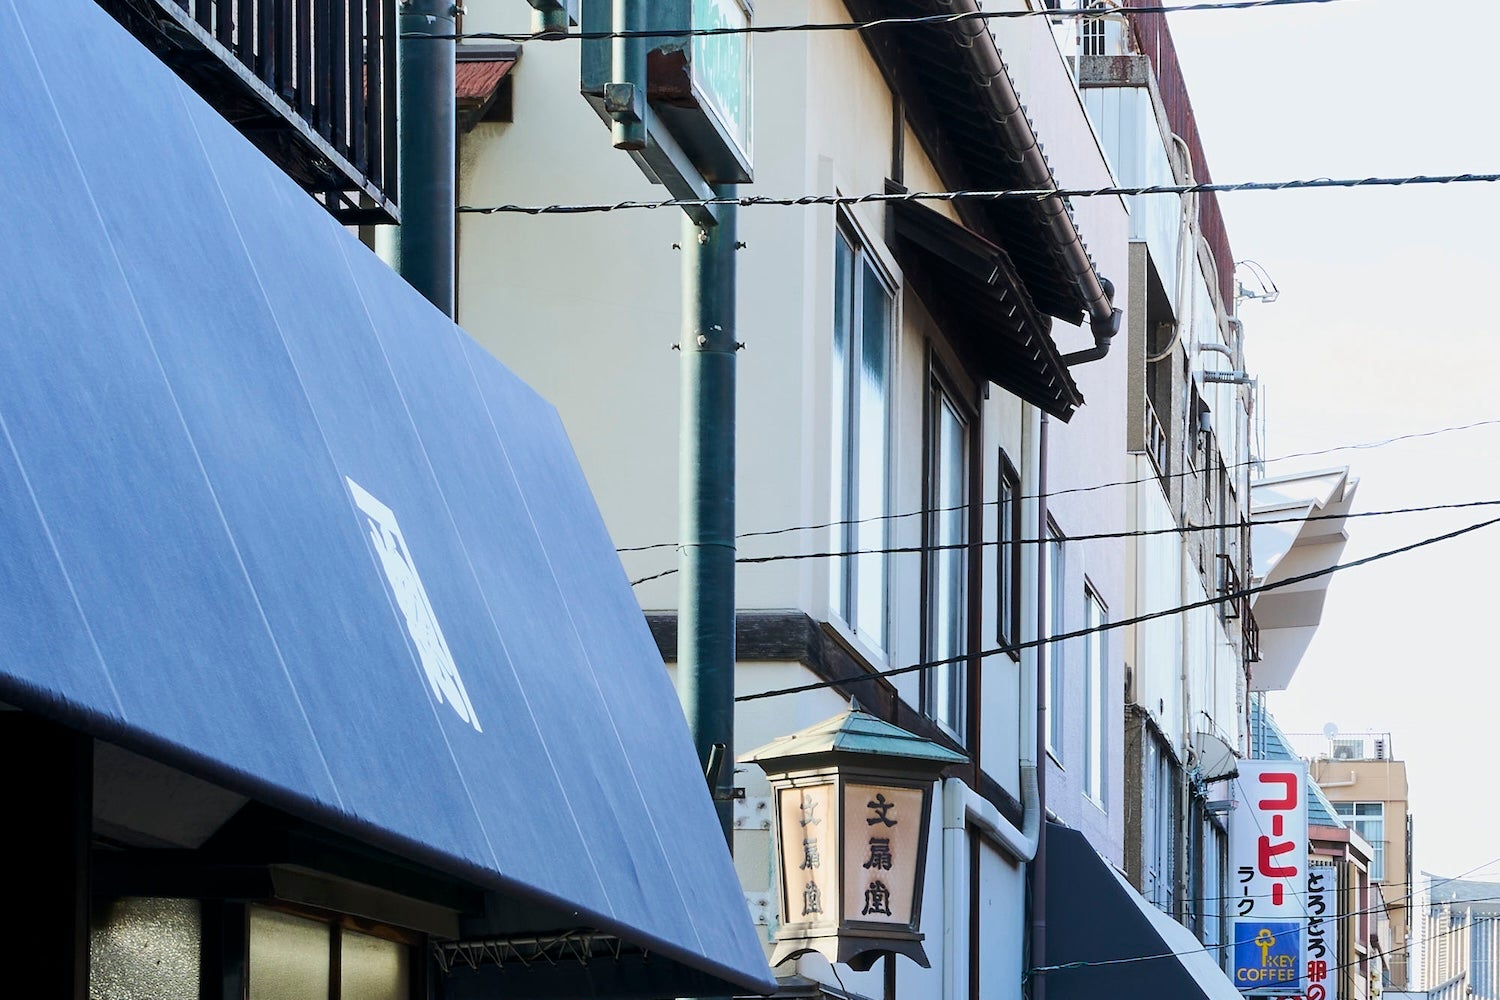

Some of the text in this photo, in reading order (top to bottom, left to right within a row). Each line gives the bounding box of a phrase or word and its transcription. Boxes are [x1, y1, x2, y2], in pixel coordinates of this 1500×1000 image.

[800, 793, 823, 917] 文扇堂
[861, 793, 898, 917] 文扇堂
[1258, 772, 1298, 906] コーヒー
[1237, 866, 1254, 916] ラーク
[1237, 968, 1295, 982] COFFEE
[1268, 955, 1296, 967] KEY
